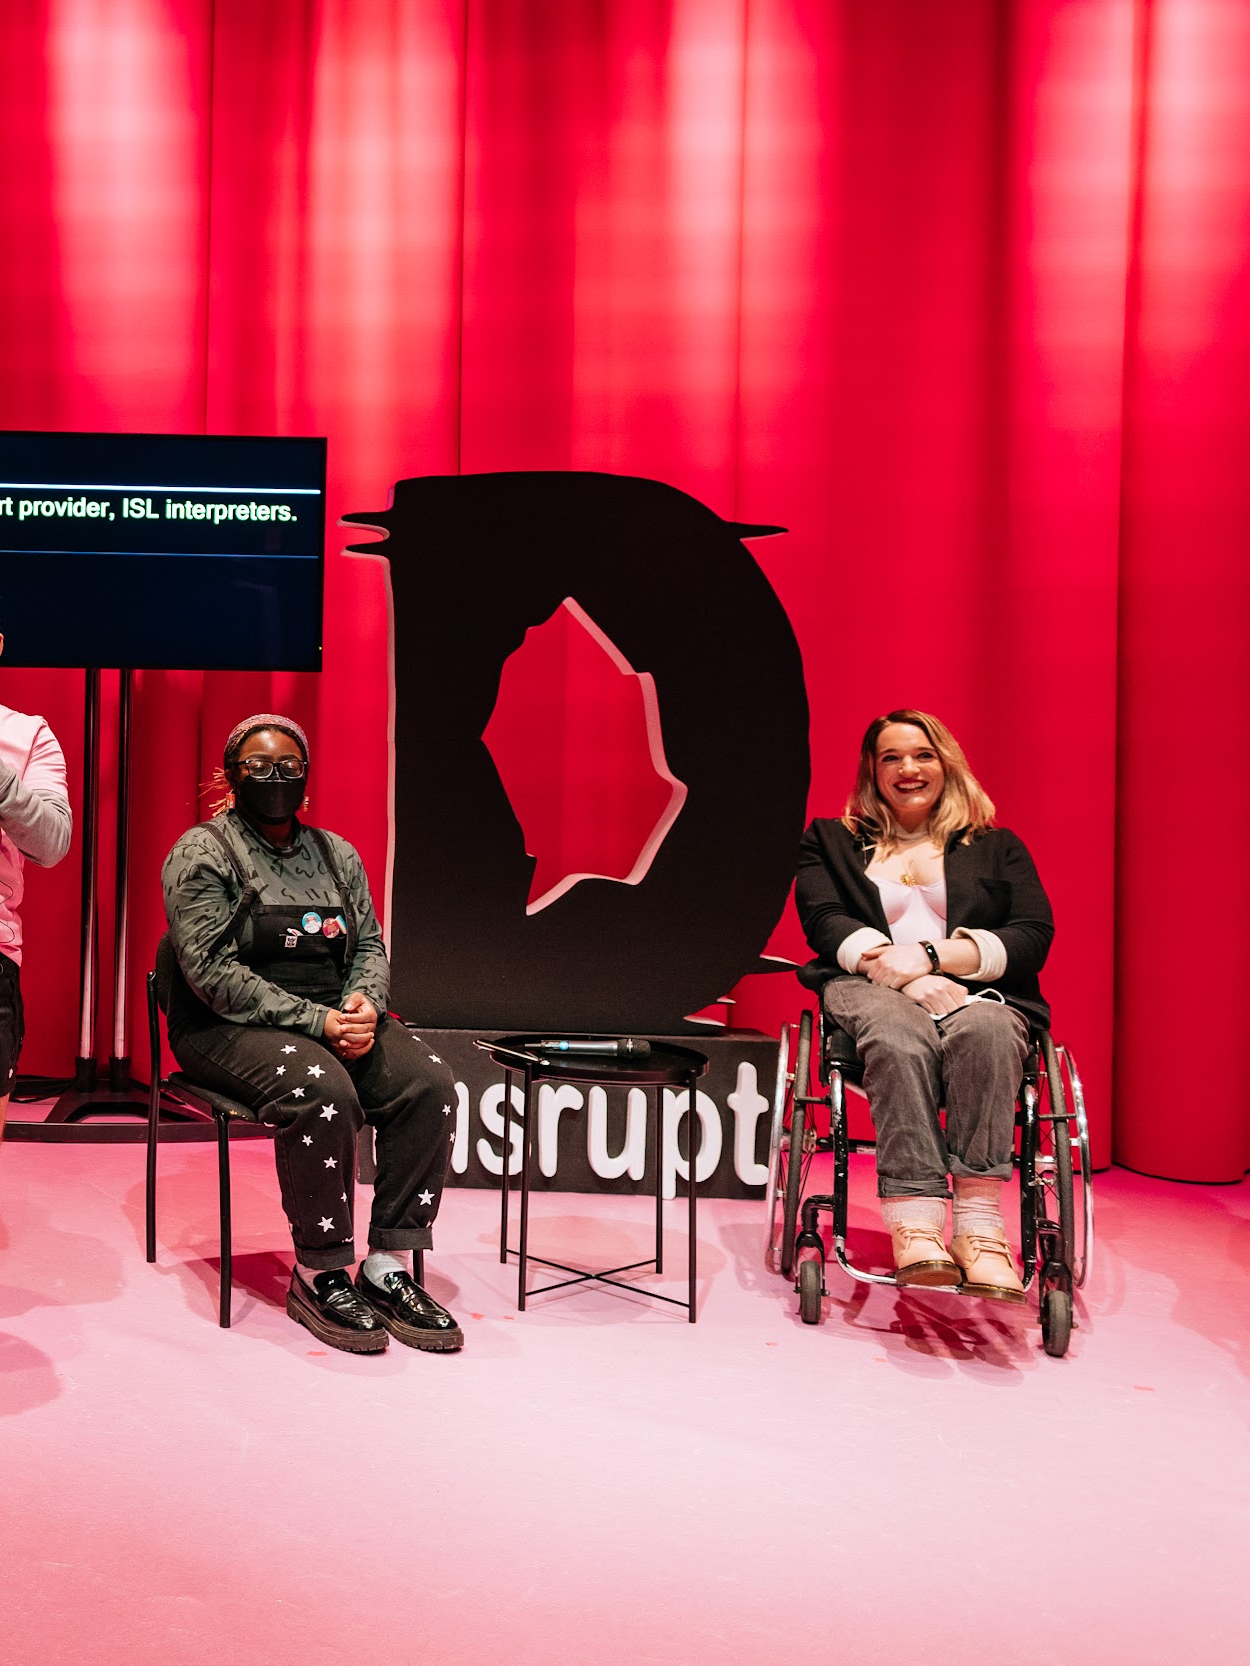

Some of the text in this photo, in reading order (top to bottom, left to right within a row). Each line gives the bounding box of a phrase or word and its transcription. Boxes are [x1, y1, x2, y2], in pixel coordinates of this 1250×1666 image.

[18, 497, 115, 521] provider,
[122, 497, 159, 519] ISL
[165, 498, 298, 525] interpreters.
[372, 1060, 770, 1200] isrupt
